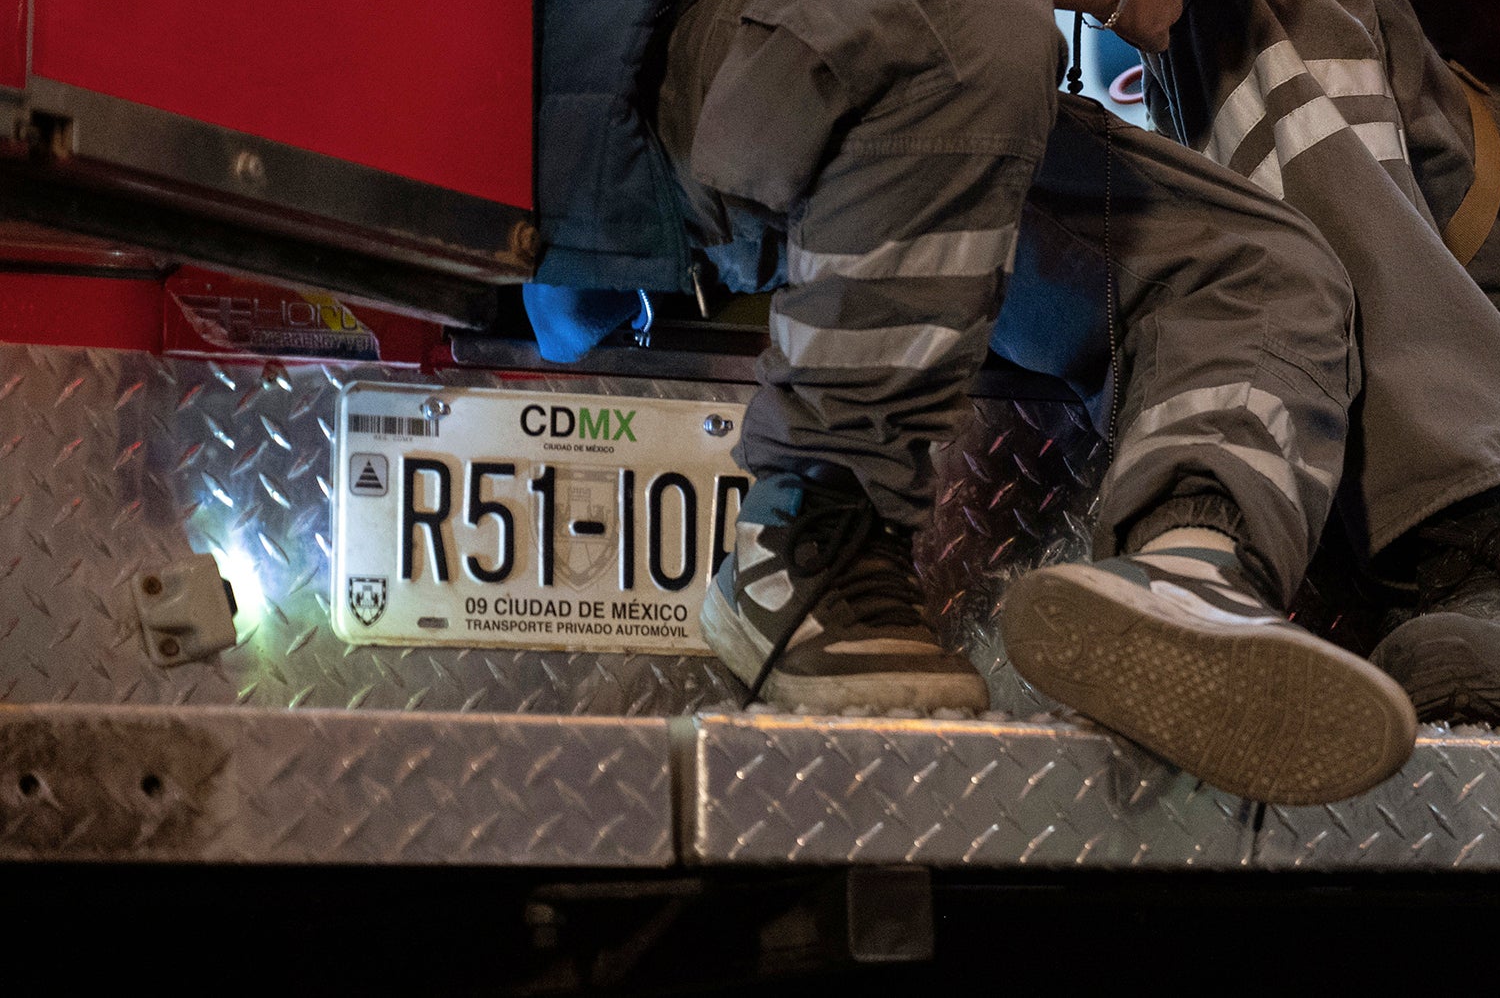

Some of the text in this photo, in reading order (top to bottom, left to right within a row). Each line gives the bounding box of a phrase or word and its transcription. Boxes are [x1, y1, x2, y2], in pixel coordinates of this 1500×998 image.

[519, 404, 638, 442] CDMX
[543, 443, 572, 452] CIUDAD
[574, 444, 584, 452] DE
[465, 597, 688, 622] 09 CIUDAD DE MÉXICO
[465, 619, 689, 638] TRANSPORTE PRIVADO AUTOMÓVIL
